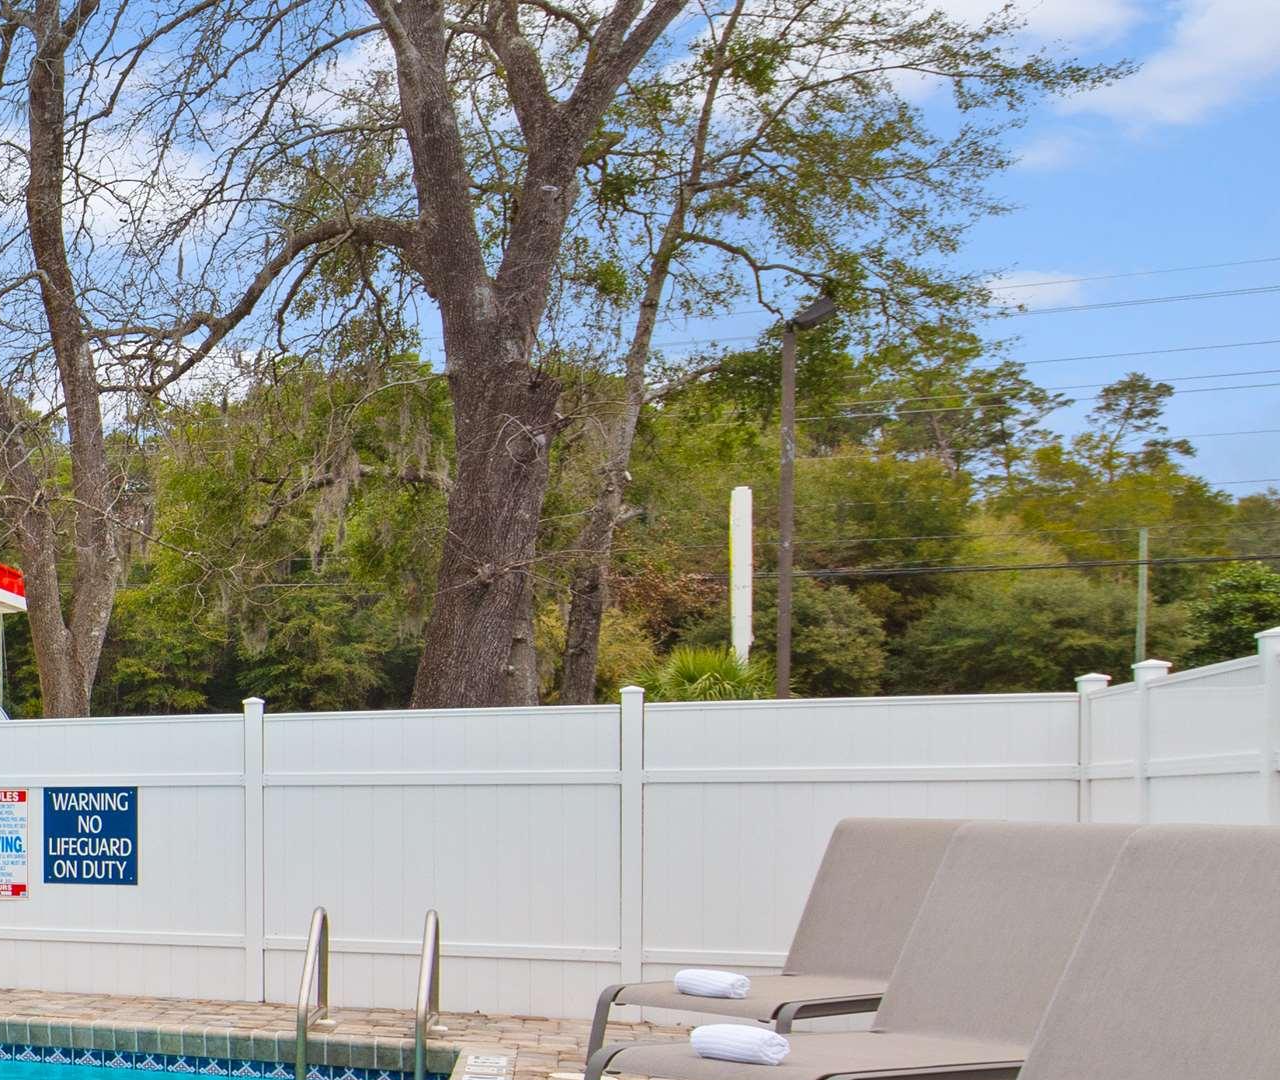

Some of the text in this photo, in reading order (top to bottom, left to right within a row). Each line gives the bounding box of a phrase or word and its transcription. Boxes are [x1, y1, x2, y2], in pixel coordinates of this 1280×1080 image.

[52, 792, 129, 811] WARNING
[77, 815, 103, 834] NO
[48, 837, 133, 857] LIFEGUARD
[53, 859, 127, 879] ON DUTY
